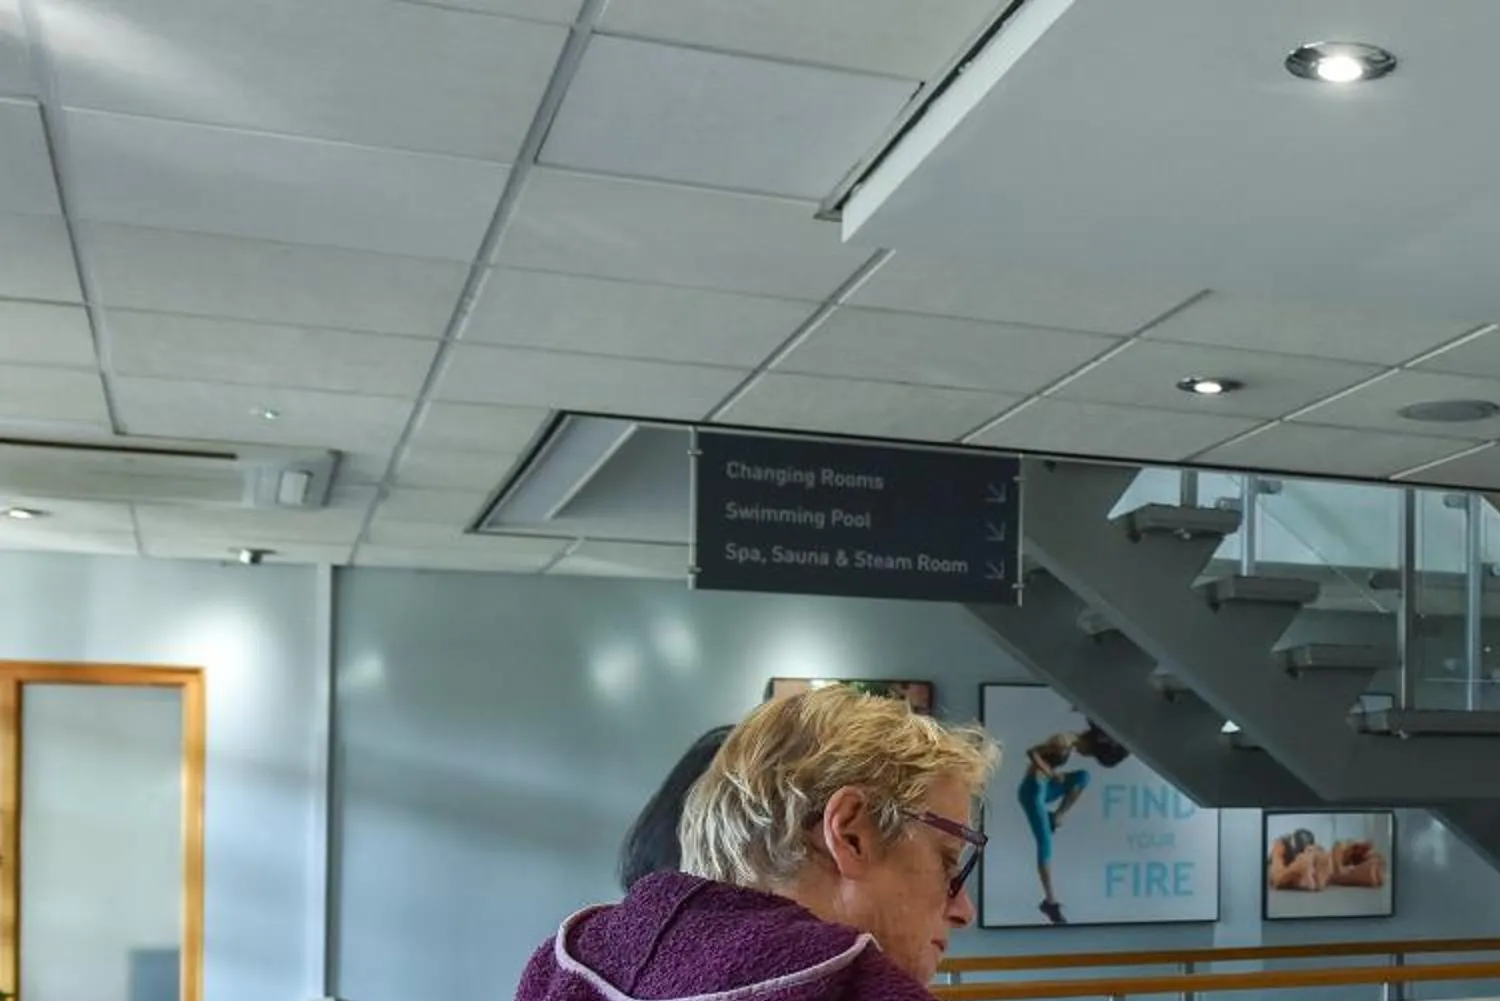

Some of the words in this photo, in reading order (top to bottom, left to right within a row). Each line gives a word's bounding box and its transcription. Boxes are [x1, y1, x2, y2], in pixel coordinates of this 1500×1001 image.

[725, 461, 816, 488] Changing
[821, 468, 885, 491] Rooms
[725, 502, 826, 529] Swimming
[831, 509, 871, 528] Pool
[725, 542, 767, 565] Spa,
[772, 545, 829, 567] Sauna
[835, 549, 849, 568] &
[854, 551, 913, 571] Steam
[917, 554, 968, 574] Room
[1103, 783, 1196, 819] FIND
[1126, 831, 1177, 850] YOUR
[1104, 861, 1197, 897] FIRE
